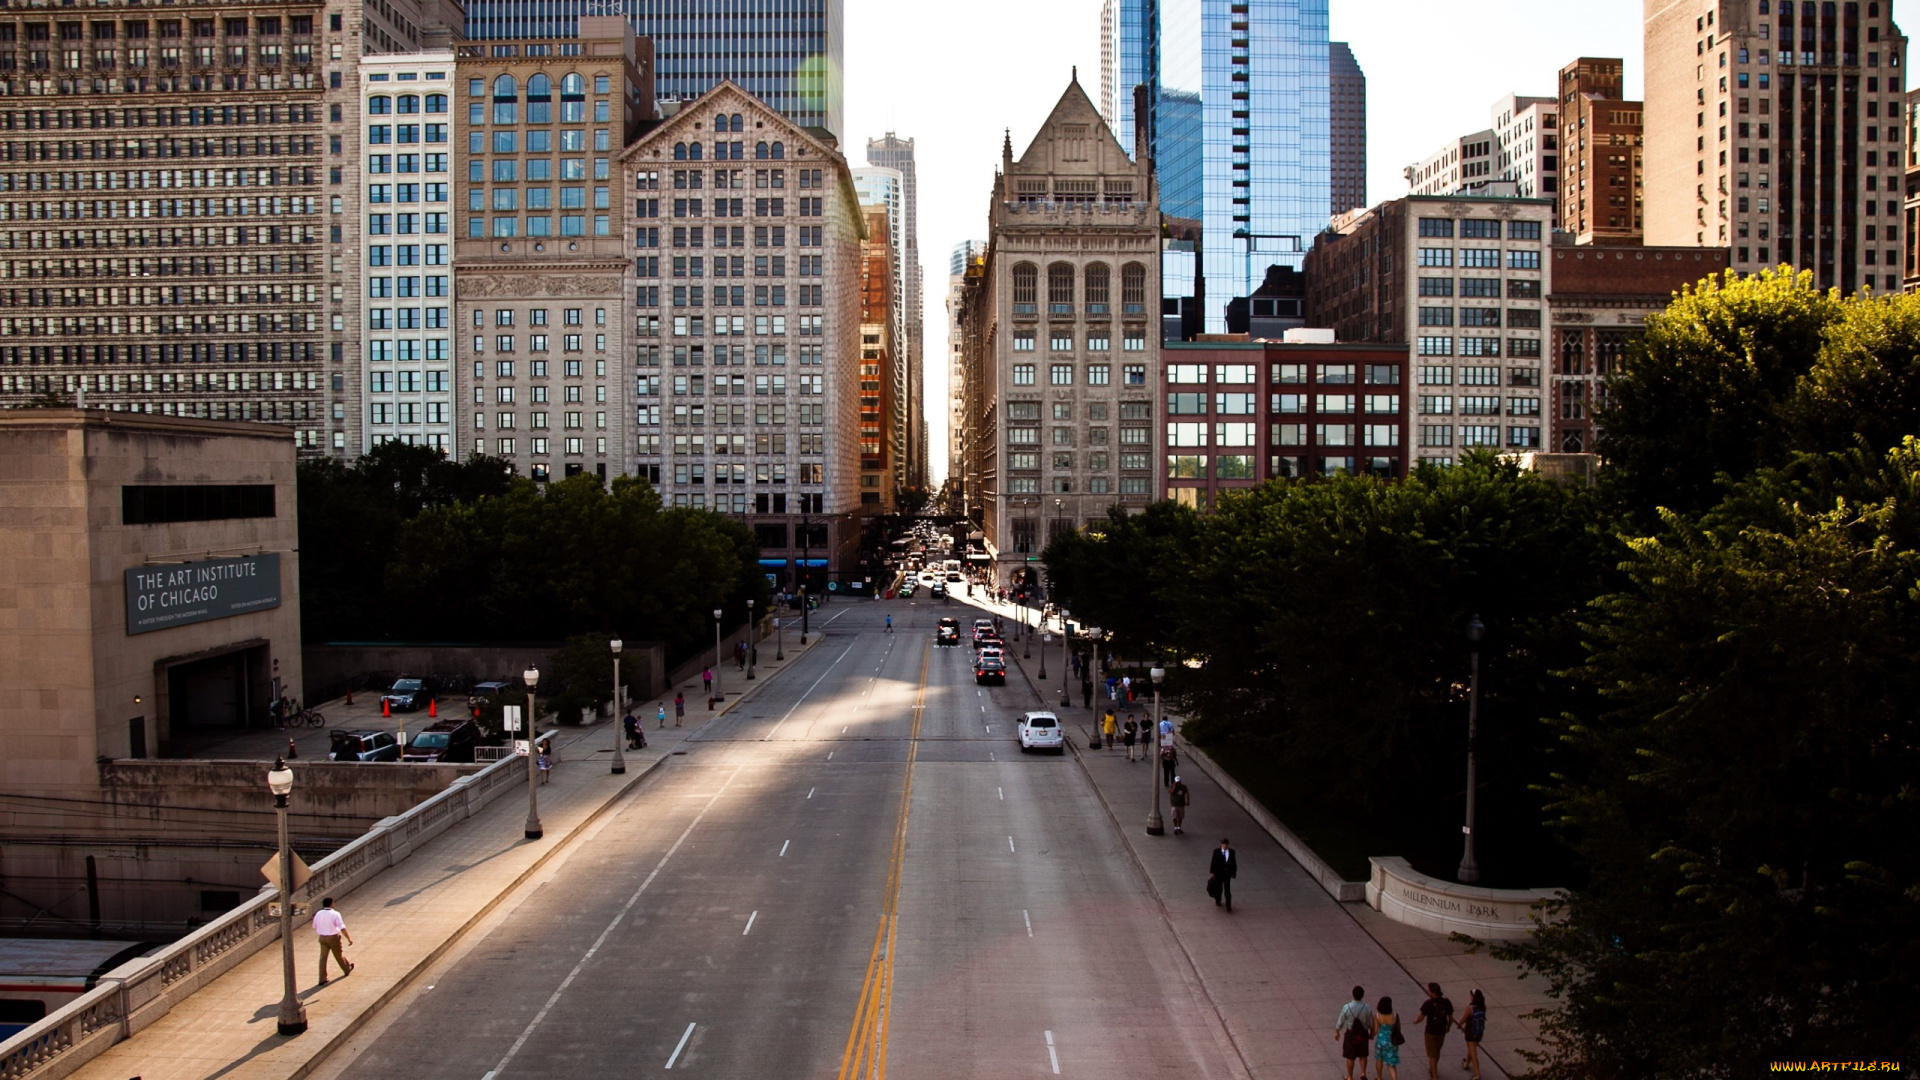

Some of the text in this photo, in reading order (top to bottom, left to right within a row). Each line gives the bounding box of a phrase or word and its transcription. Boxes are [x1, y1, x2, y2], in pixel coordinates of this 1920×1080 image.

[137, 562, 256, 590] THE ART INSTITUTE
[138, 585, 218, 611] OF CHICAGO
[142, 617, 155, 625] ENTER
[155, 614, 174, 623] THROUGH
[182, 610, 197, 618] MODERN
[1402, 889, 1499, 918] MILLENNIUM PARK
